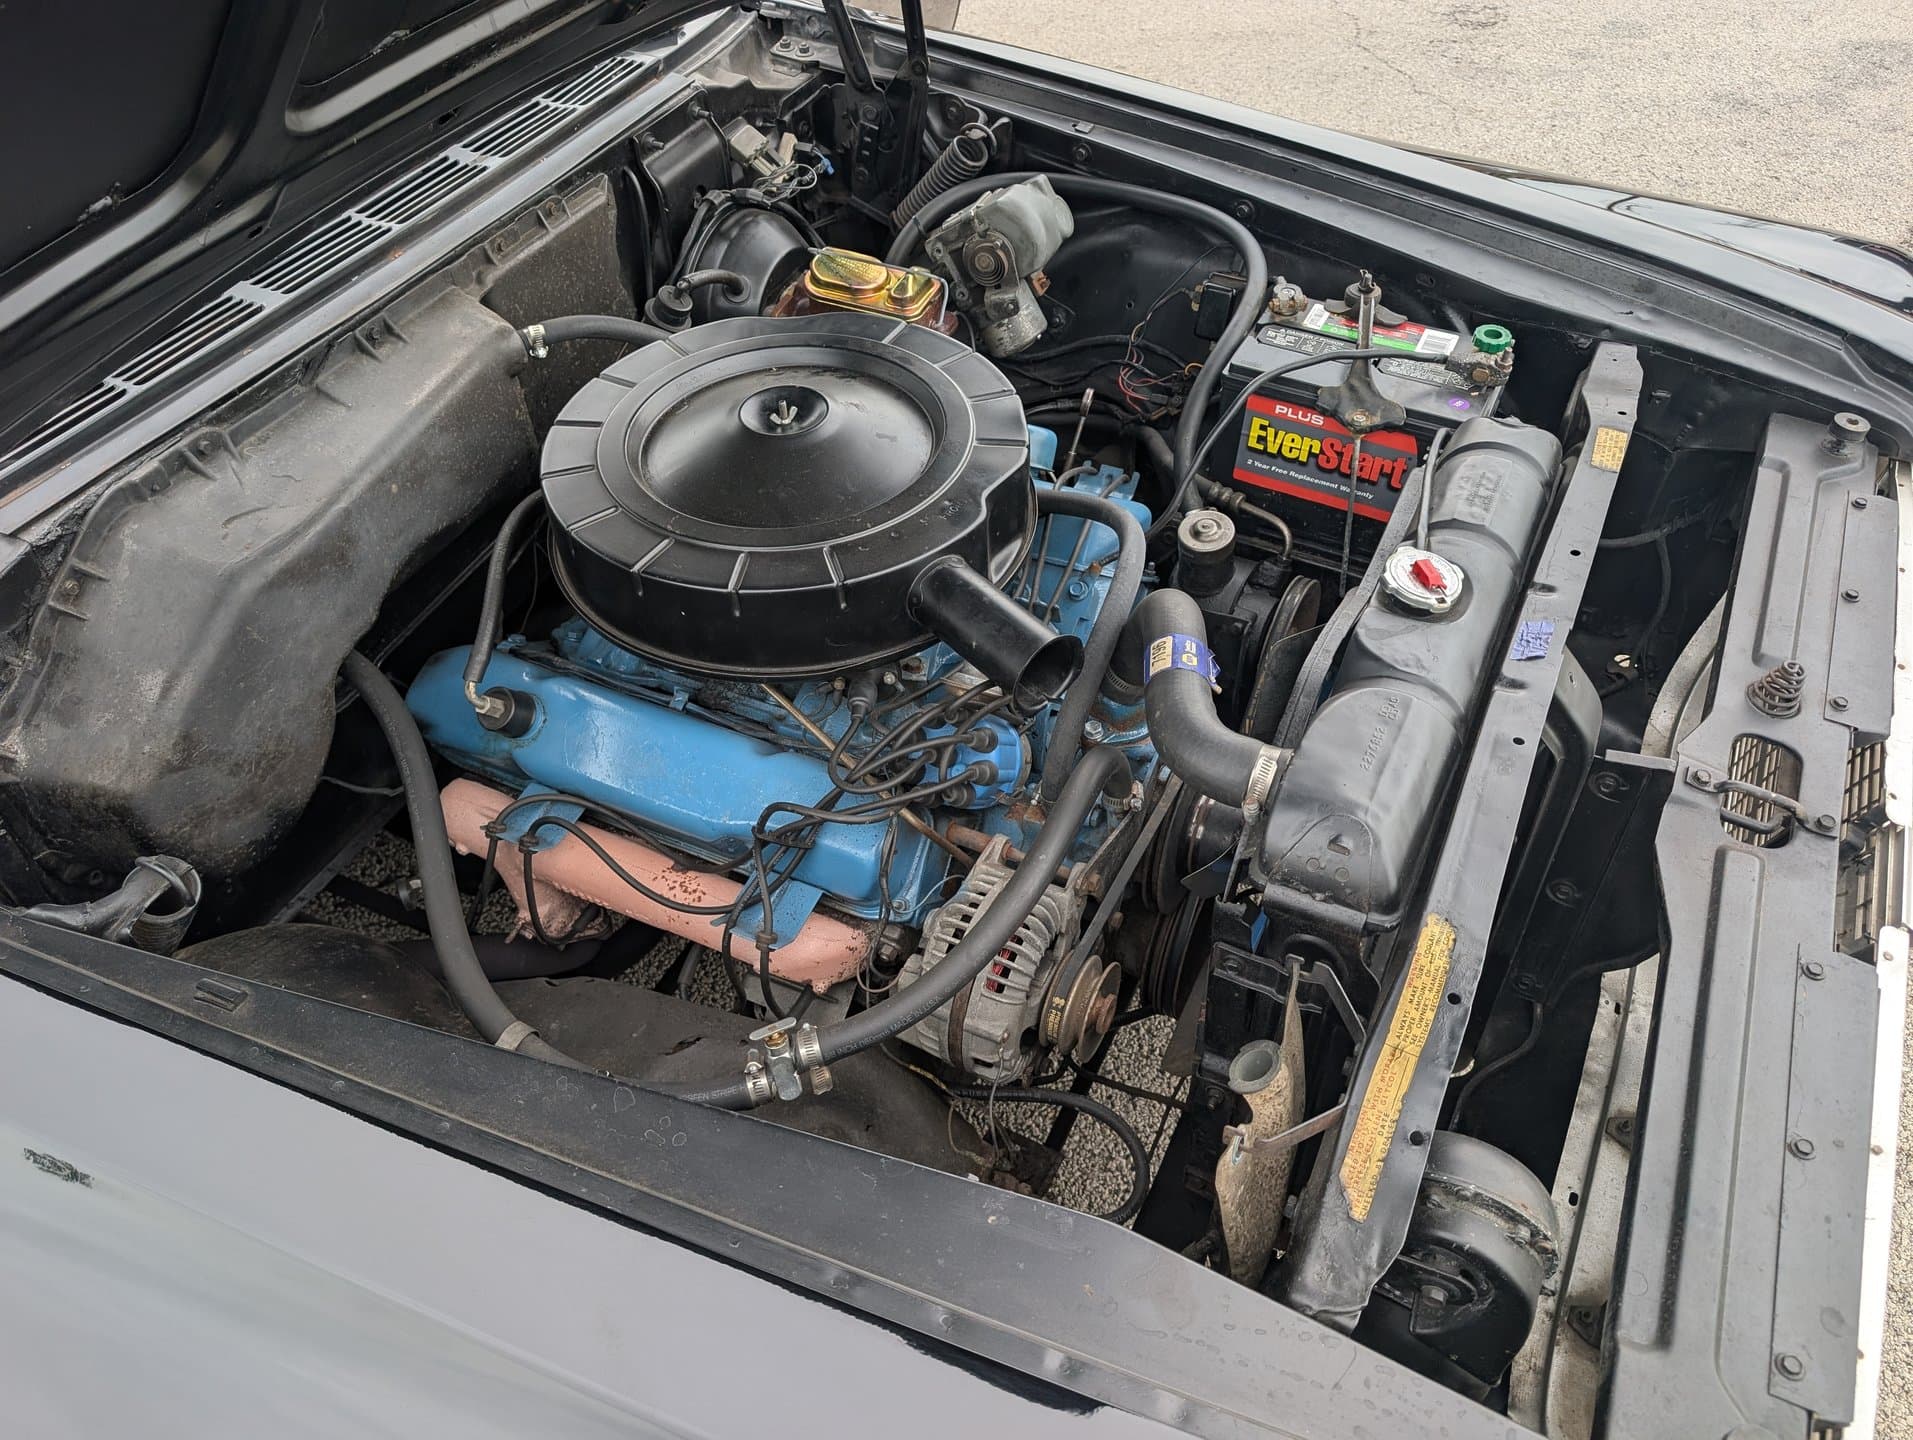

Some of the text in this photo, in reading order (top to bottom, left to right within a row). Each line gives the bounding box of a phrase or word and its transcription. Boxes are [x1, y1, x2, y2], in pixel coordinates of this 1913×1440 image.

[1274, 404, 1325, 426] PLUS
[1248, 416, 1408, 490] EverStart
[1254, 460, 1271, 470] Year
[1271, 465, 1288, 476] Free
[1289, 470, 1342, 490] Replacement
[1340, 482, 1374, 500] Waranty
[1152, 640, 1167, 667] 7196
[1395, 1008, 1410, 1040] ALWAYS
[1407, 985, 1418, 1004] MAKE
[1415, 963, 1425, 980] SURE
[1423, 930, 1436, 959] COOLANT
[1402, 1015, 1415, 1043] PROPER
[1413, 981, 1427, 1011] AMOUNT
[1424, 968, 1432, 977] OF
[1409, 928, 1452, 1045] SEE OWNER'S MANUAL FOR COOL
[1416, 1017, 1431, 1048] SYSTEMS
[1376, 1111, 1390, 1136] DATE
[1359, 1173, 1378, 1217] CHECKED
